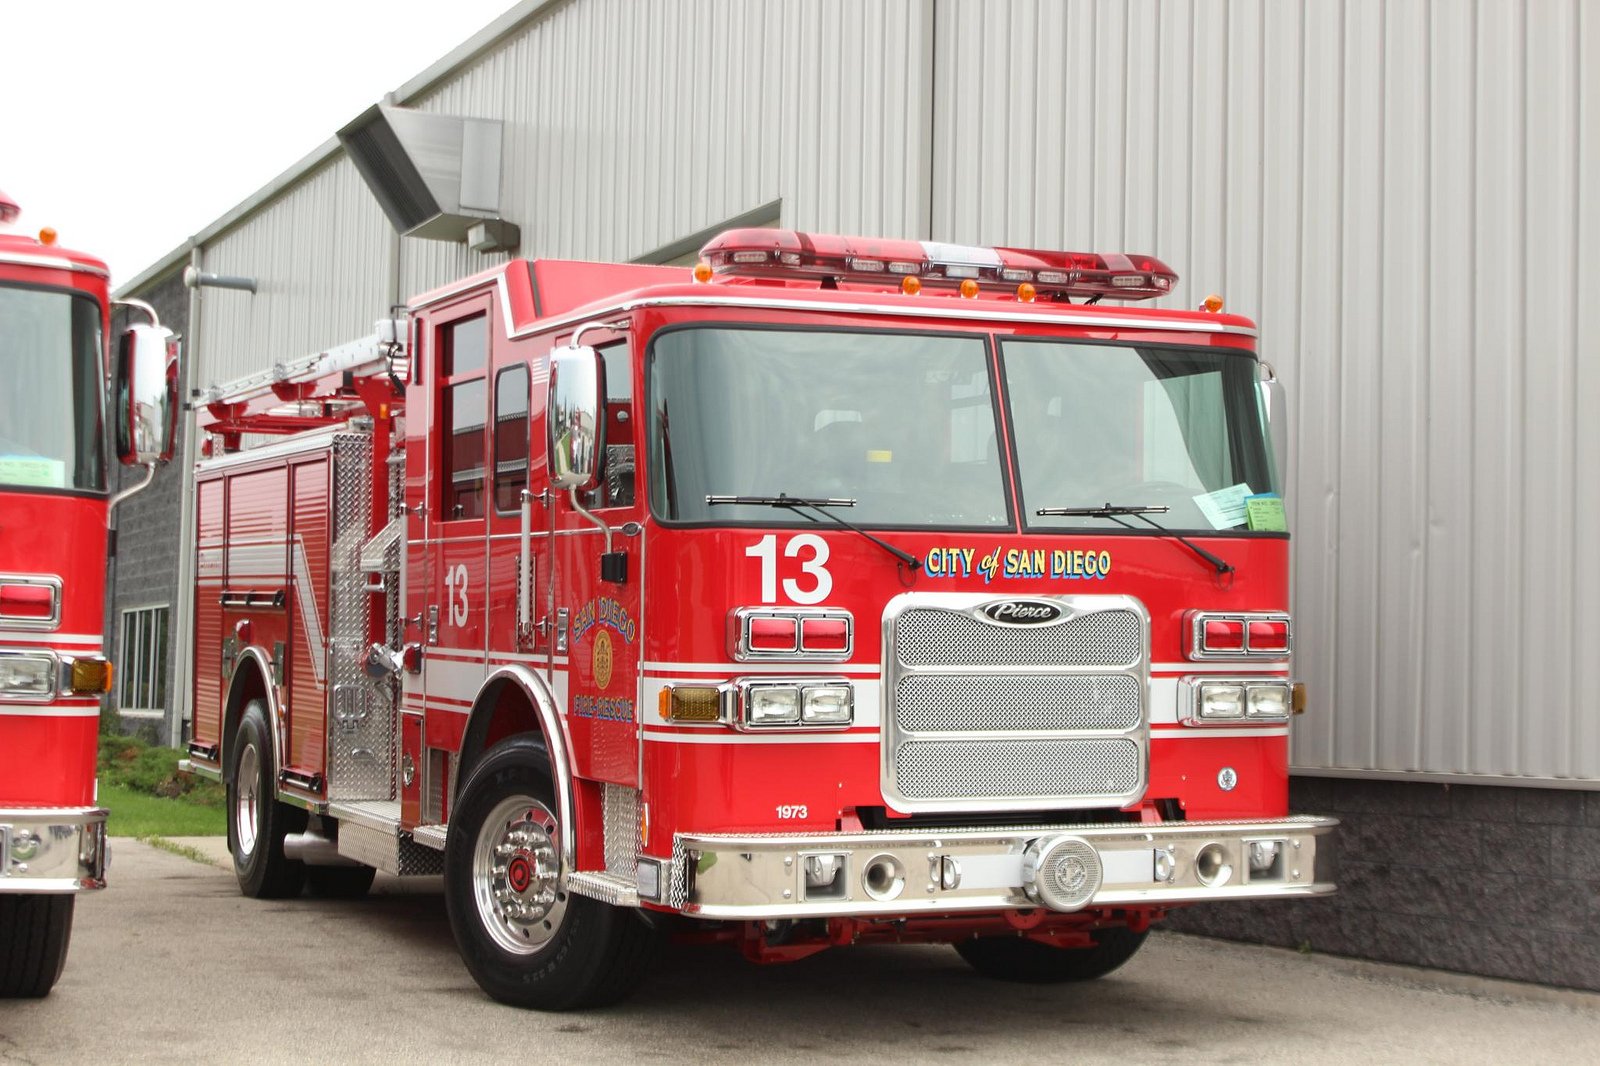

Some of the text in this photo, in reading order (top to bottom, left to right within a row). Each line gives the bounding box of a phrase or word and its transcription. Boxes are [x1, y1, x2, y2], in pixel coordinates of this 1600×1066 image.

[745, 533, 833, 605] 13
[924, 546, 1112, 584] CITY of SAN DIEGO
[445, 564, 469, 628] 13
[993, 601, 1051, 620] Pierce
[573, 597, 635, 645] SAN DIEGO
[776, 804, 808, 819] 1973
